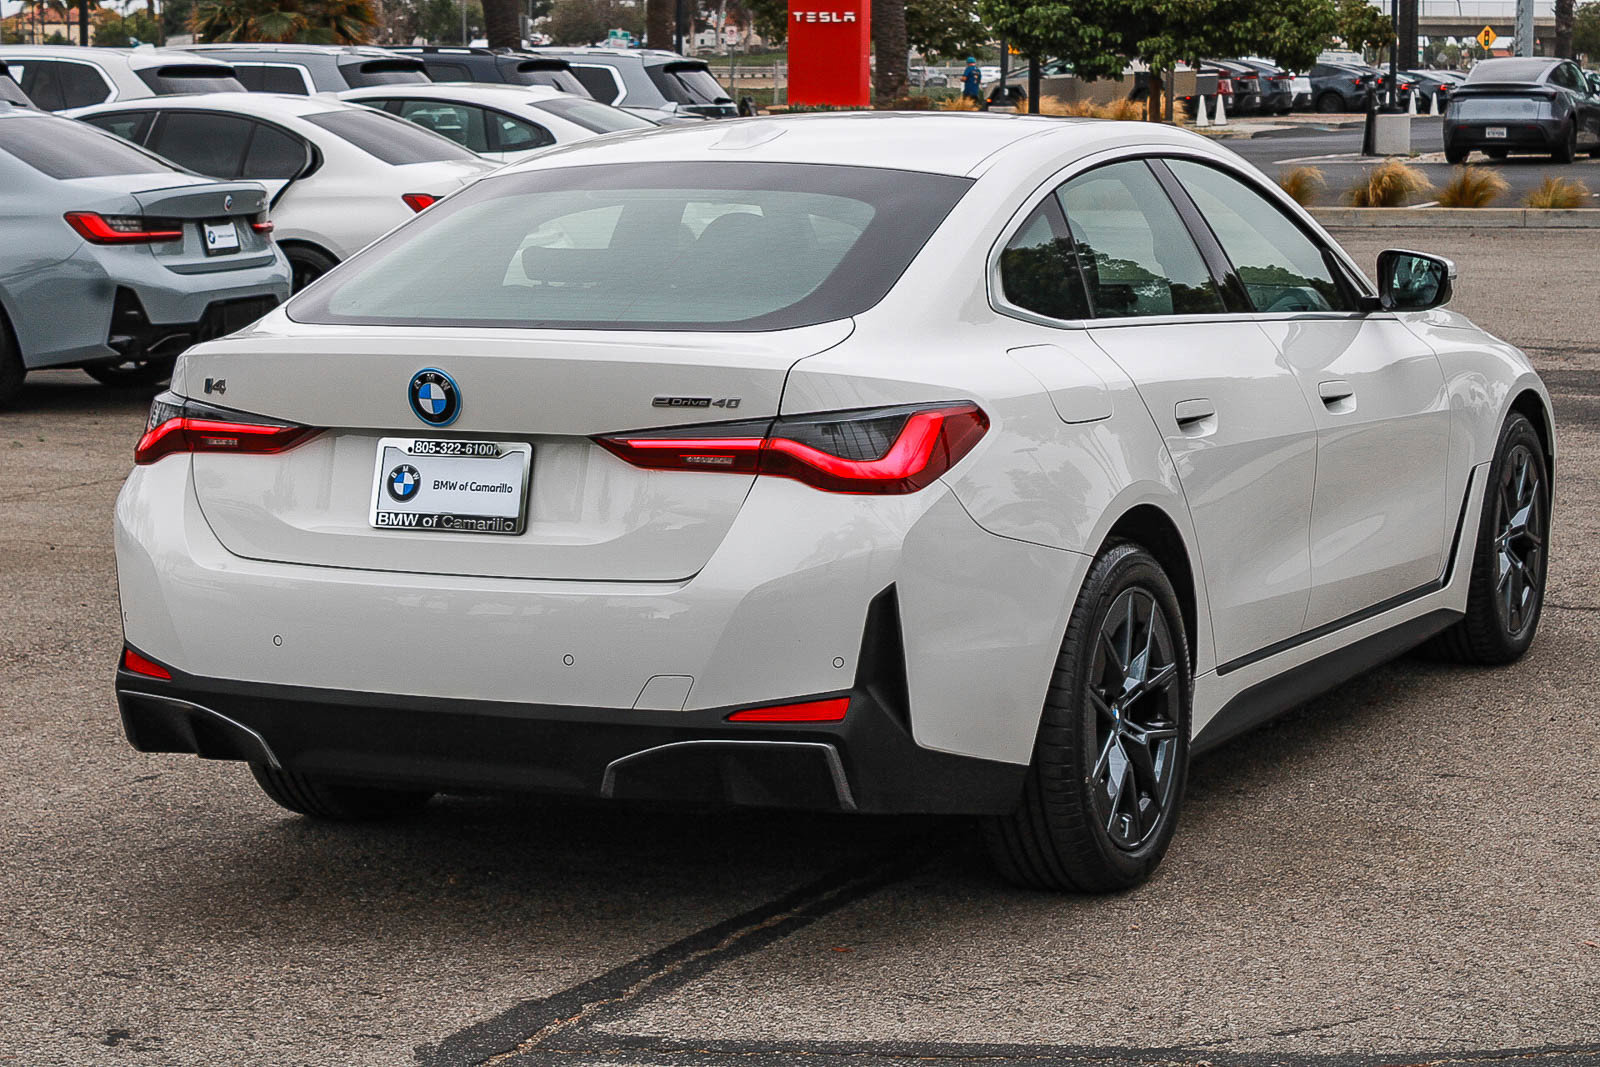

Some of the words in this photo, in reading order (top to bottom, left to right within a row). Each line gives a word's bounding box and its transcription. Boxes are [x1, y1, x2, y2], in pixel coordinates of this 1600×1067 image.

[792, 11, 856, 23] TESLA
[414, 373, 451, 391] BMW
[712, 398, 742, 408] 40
[415, 441, 494, 456] 805-322-6100
[433, 480, 457, 491] BMW
[459, 480, 469, 491] of
[470, 481, 513, 494] Camarillo
[377, 512, 419, 527] BMW
[422, 515, 438, 528] of
[441, 515, 514, 532] Camarillo
